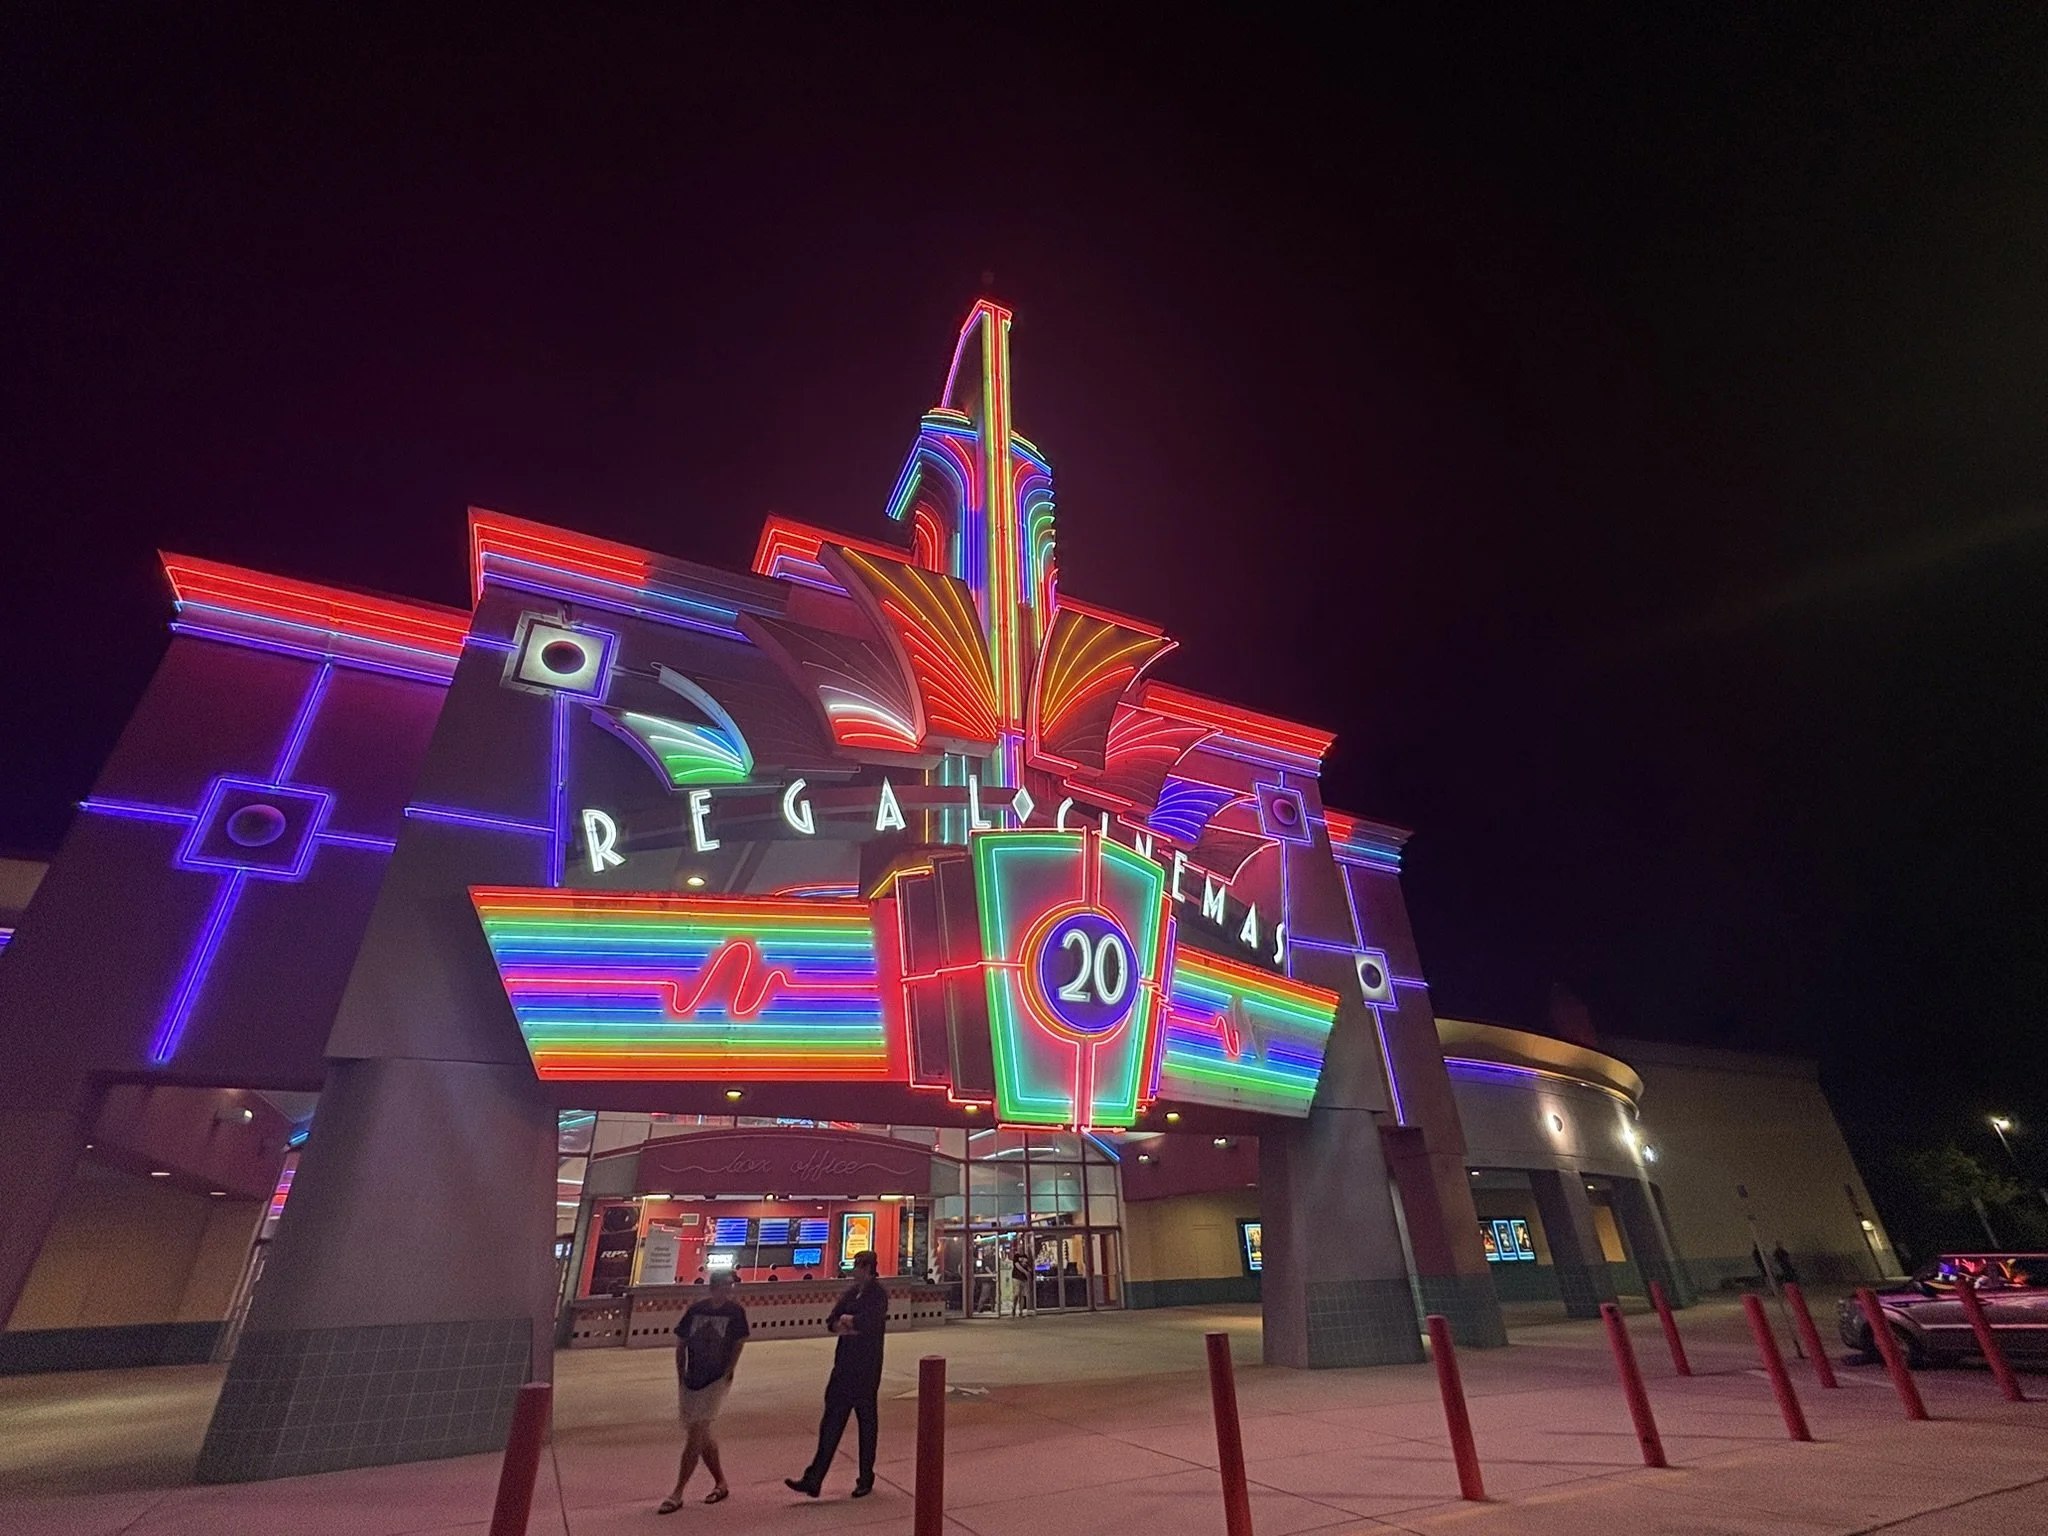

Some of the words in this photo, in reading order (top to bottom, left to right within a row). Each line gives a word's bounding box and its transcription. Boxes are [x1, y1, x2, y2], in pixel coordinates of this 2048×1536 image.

[582, 774, 991, 873] REGAL
[1057, 928, 1129, 1005] 20
[789, 1150, 860, 1181] office
